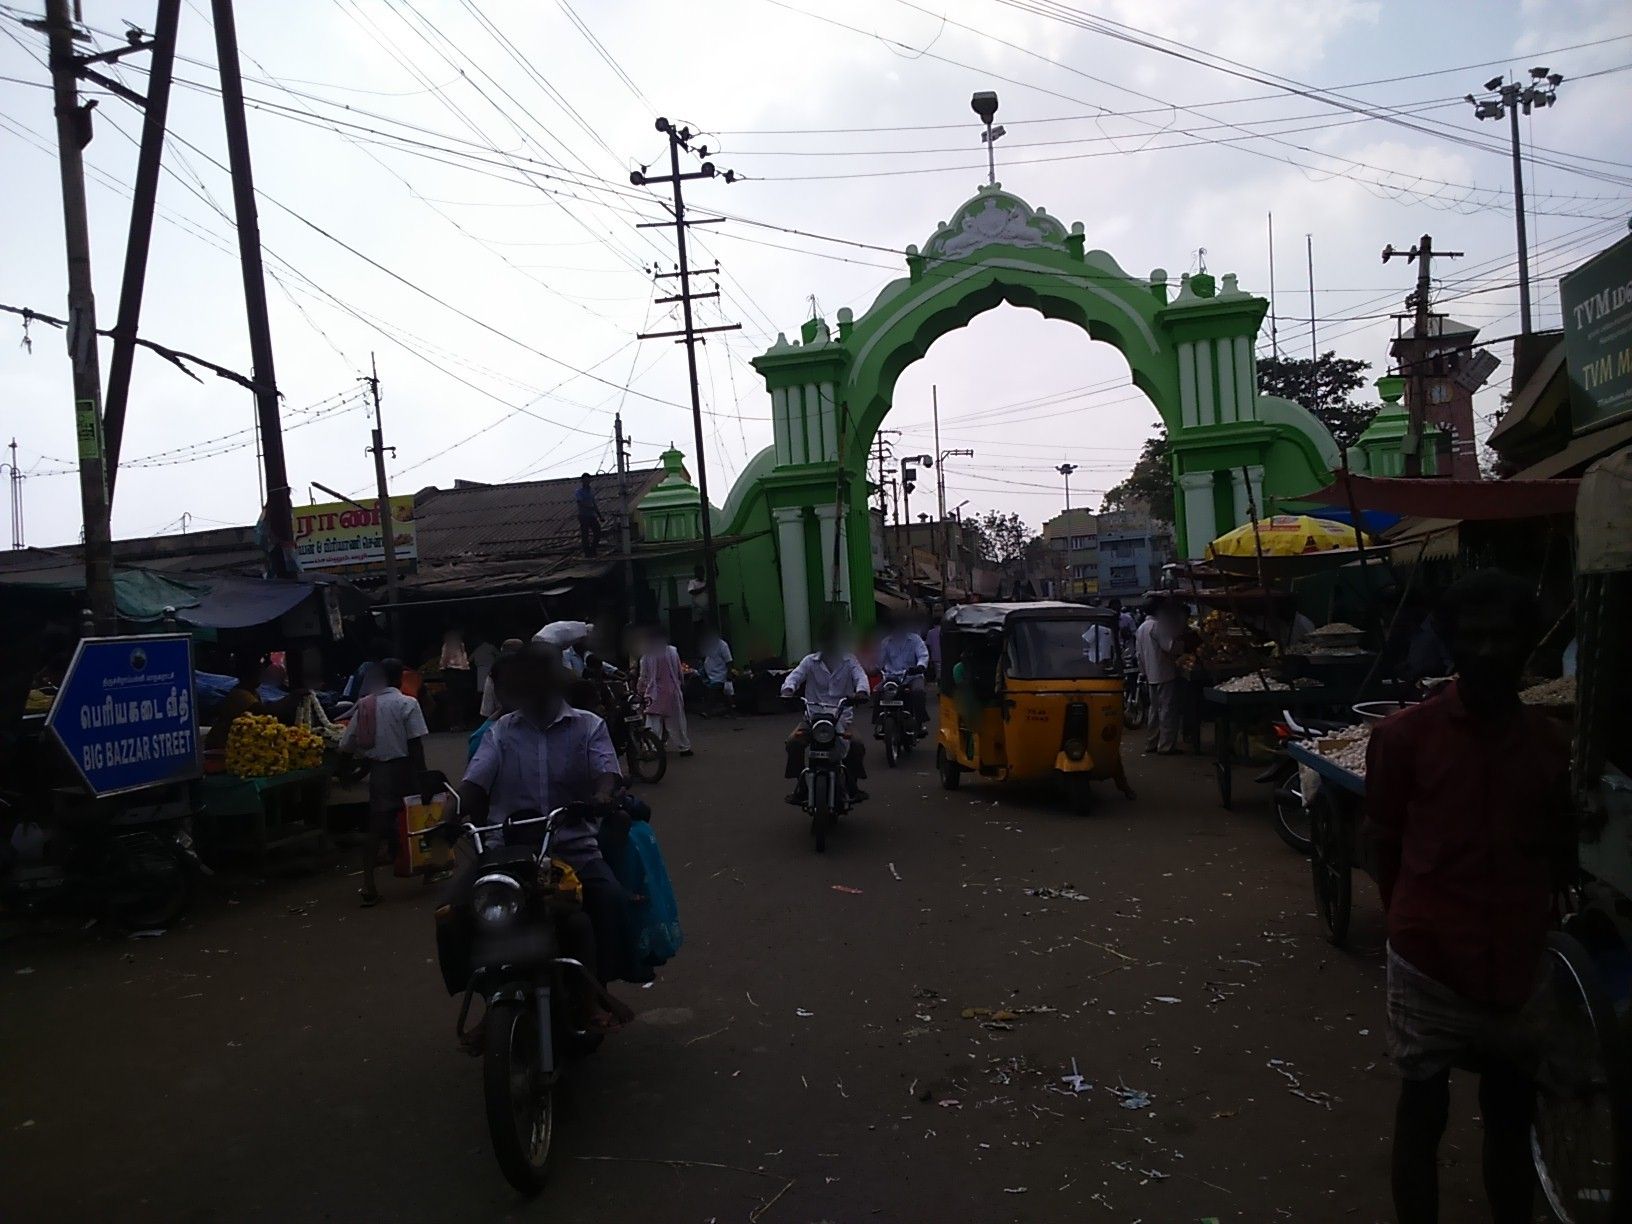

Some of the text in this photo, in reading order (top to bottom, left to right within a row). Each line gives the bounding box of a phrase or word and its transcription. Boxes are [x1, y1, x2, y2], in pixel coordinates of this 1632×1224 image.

[1573, 288, 1611, 330] TVM
[1582, 348, 1632, 391] TVM M
[80, 686, 190, 731] பெரியகடை வீதி
[82, 730, 191, 771] BIG BAZZAR STREET
